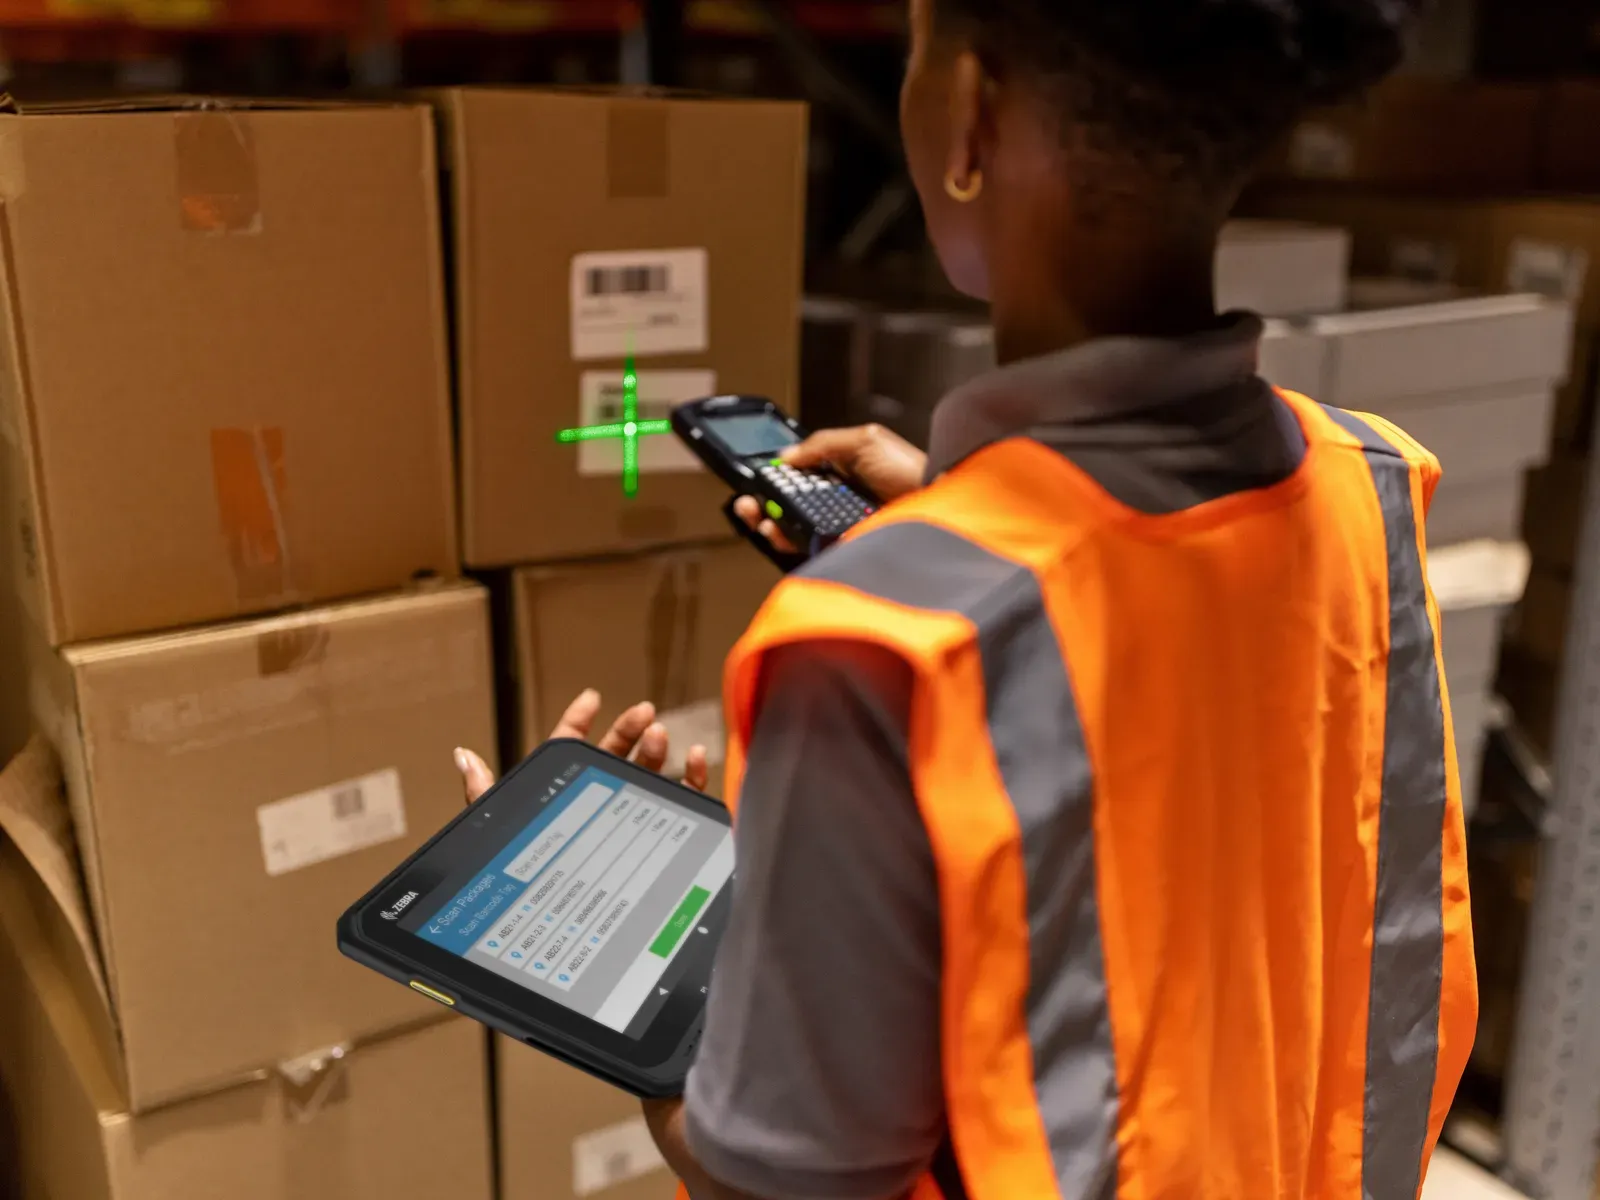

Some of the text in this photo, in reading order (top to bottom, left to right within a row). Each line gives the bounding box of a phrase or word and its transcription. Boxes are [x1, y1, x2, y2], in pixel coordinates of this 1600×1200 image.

[514, 861, 534, 876] Scan
[392, 891, 419, 913] ZEBRA
[437, 873, 496, 926] Scan Packages
[458, 883, 517, 936] Scan Barcode Tag
[498, 914, 525, 940] AB21-1-4
[520, 924, 546, 951] AB21-2-3
[544, 935, 569, 962] AB22-7-4
